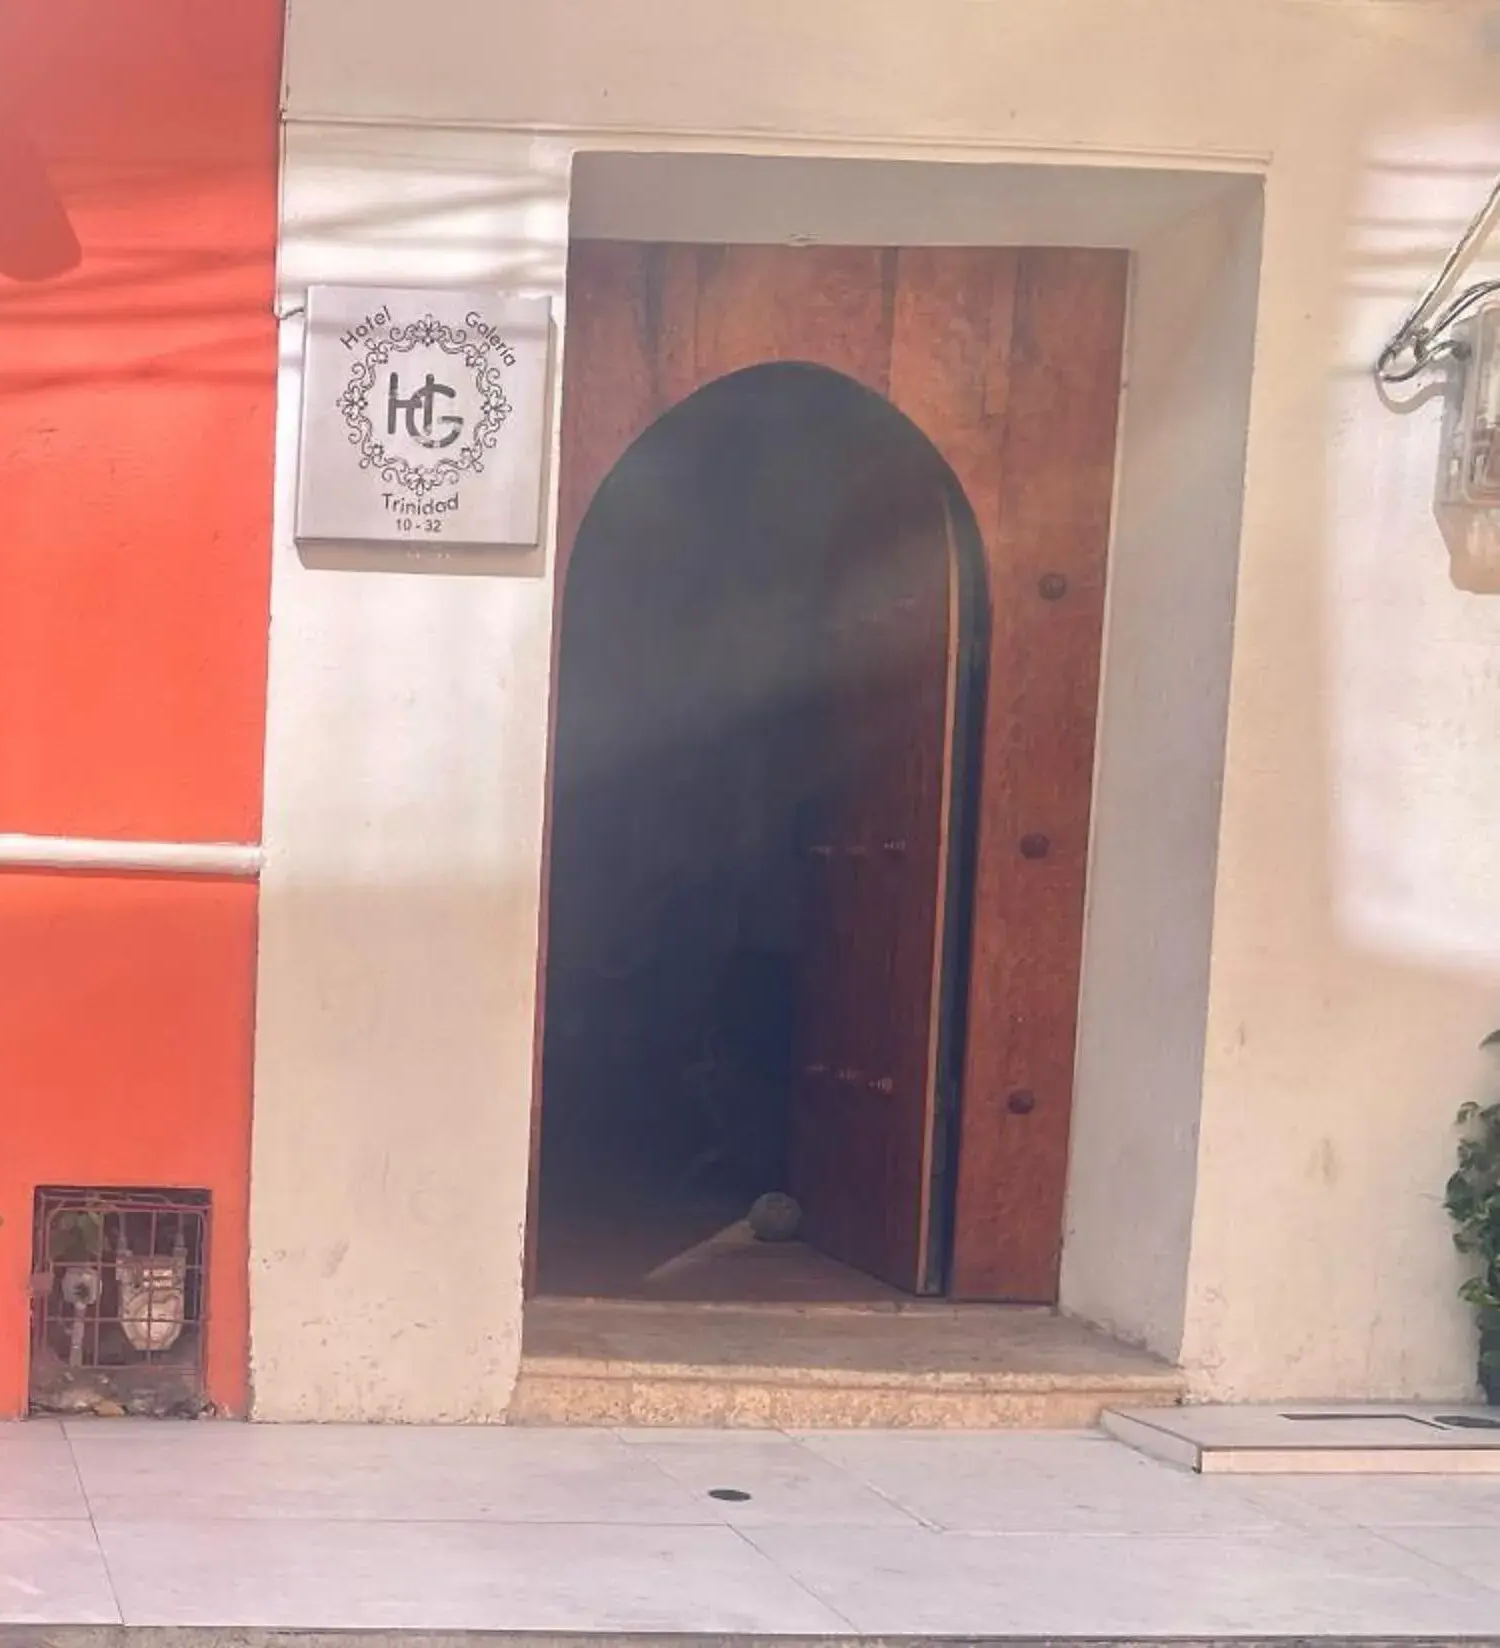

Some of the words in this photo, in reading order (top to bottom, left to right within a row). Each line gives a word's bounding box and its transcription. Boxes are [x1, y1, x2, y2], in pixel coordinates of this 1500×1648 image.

[339, 305, 392, 351] Hotel
[381, 492, 459, 515] Trinidad
[396, 518, 412, 532] 10
[424, 519, 442, 532] 32
